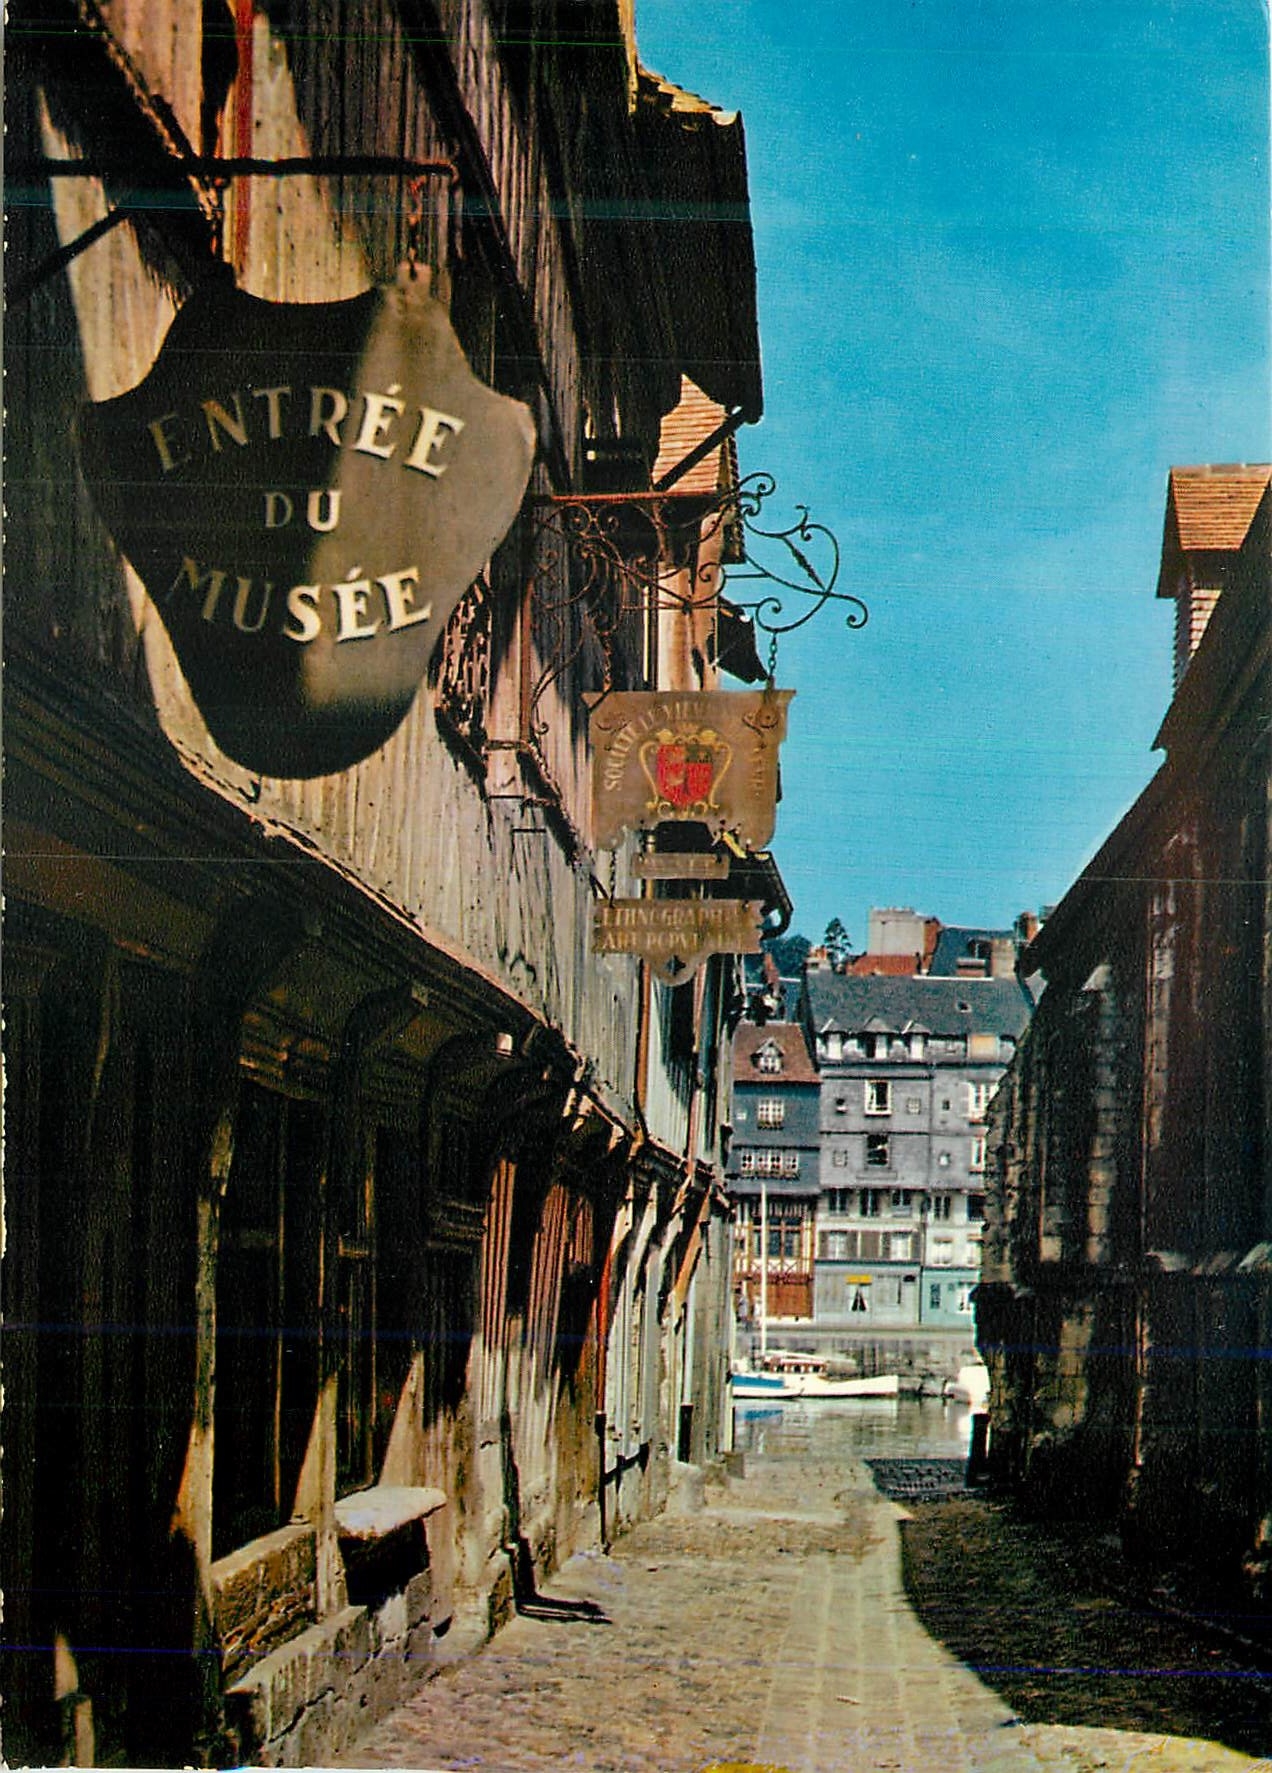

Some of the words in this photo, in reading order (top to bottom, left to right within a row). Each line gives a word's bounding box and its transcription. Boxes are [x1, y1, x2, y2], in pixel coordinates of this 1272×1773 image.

[149, 384, 465, 478] ENTRÉE
[264, 489, 342, 532] DU
[165, 556, 432, 642] MUSÉE
